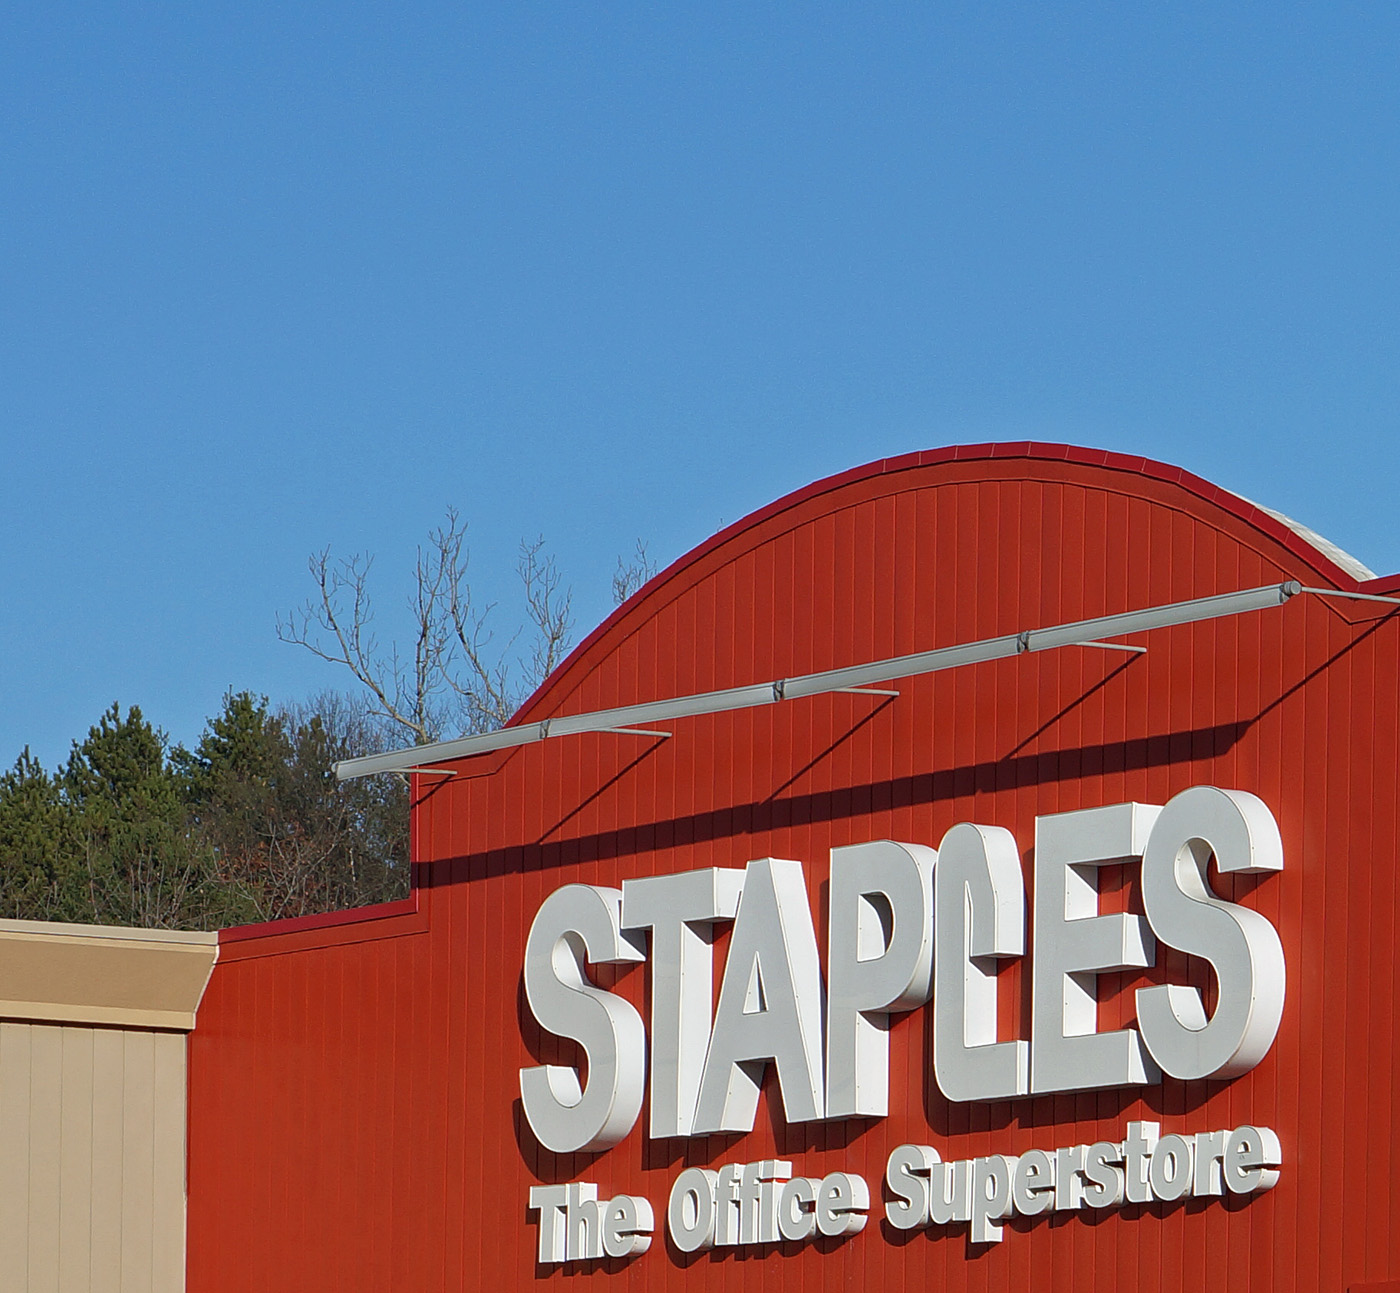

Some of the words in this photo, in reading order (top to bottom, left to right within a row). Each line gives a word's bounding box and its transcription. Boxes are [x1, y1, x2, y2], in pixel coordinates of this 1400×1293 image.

[520, 785, 1286, 1154] STAPLES
[529, 1182, 655, 1264] The
[668, 1159, 871, 1253] Office
[886, 1121, 1282, 1243] Superstore
